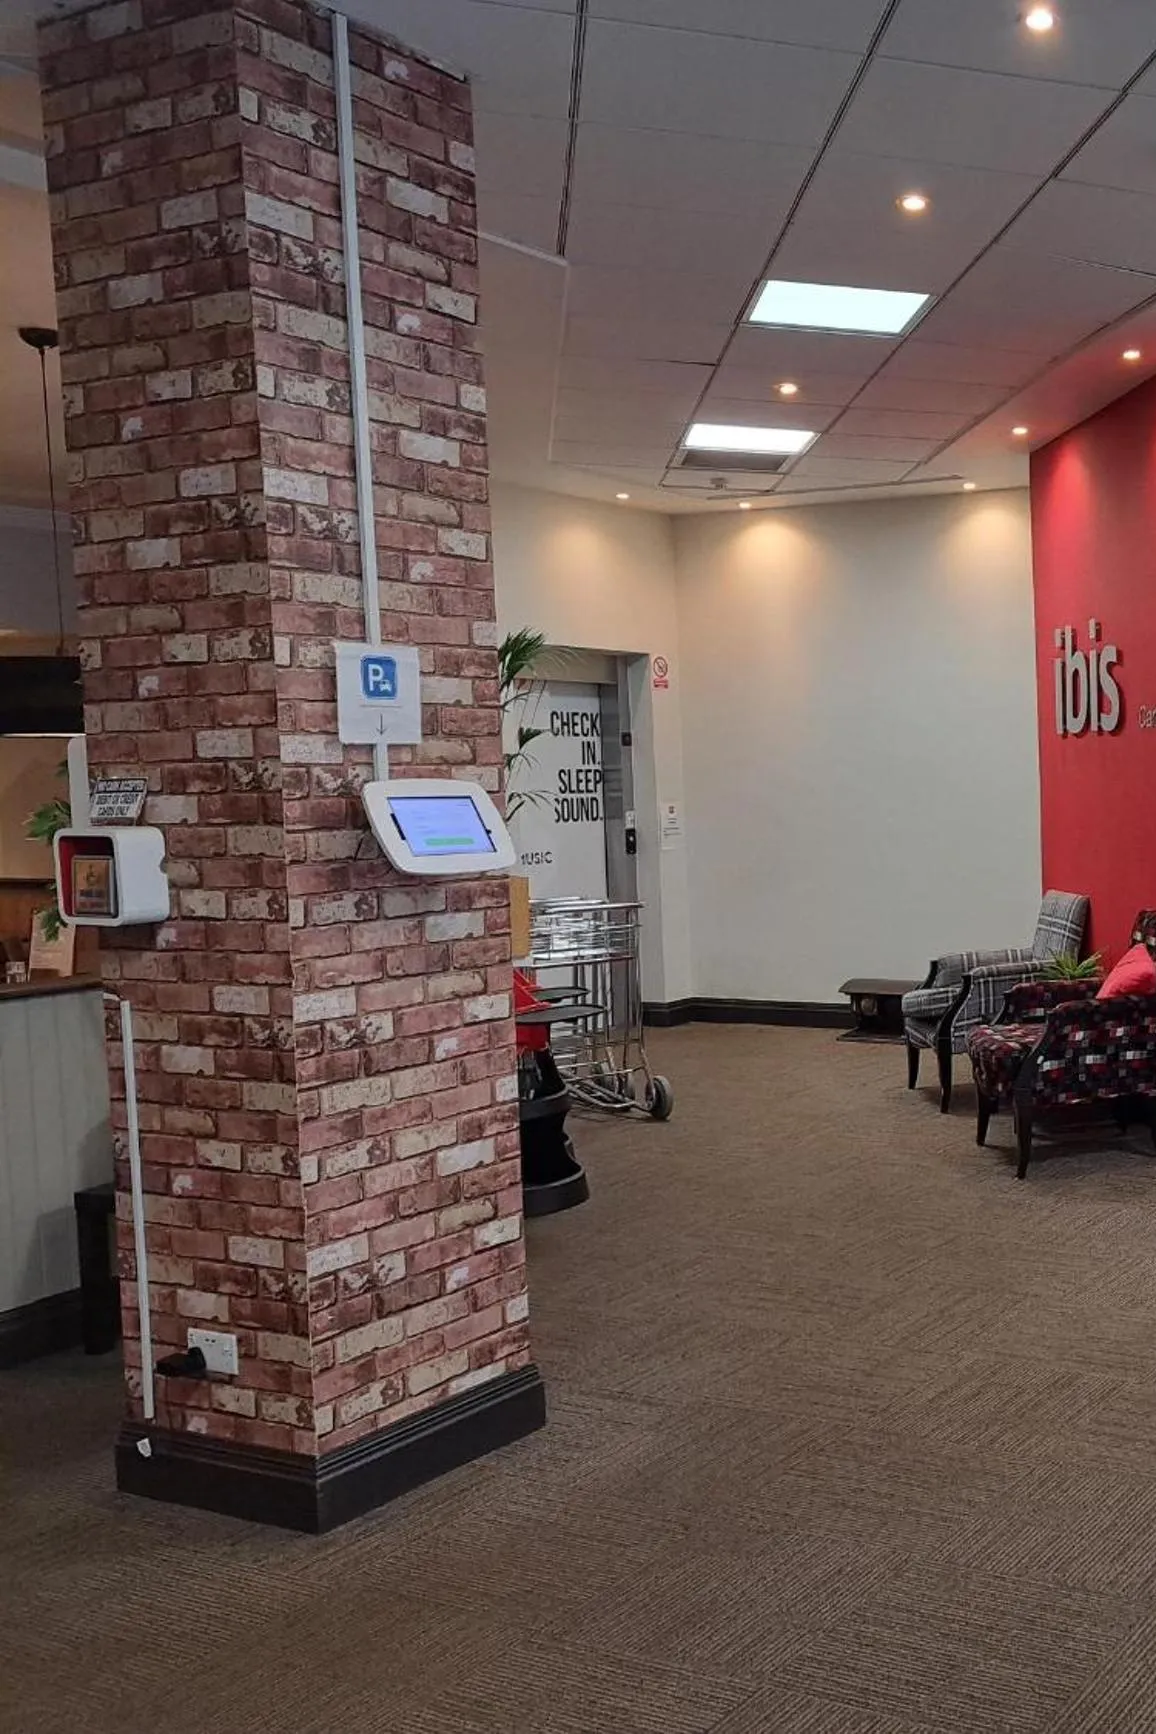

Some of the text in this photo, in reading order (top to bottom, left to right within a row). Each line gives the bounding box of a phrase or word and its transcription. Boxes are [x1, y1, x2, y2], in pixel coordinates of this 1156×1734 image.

[368, 664, 384, 691] P
[1054, 618, 1120, 735] ibis
[550, 710, 600, 738] CHECK
[581, 740, 601, 765] IN.
[558, 768, 602, 794] SLEEP
[554, 797, 603, 823] SOUND.
